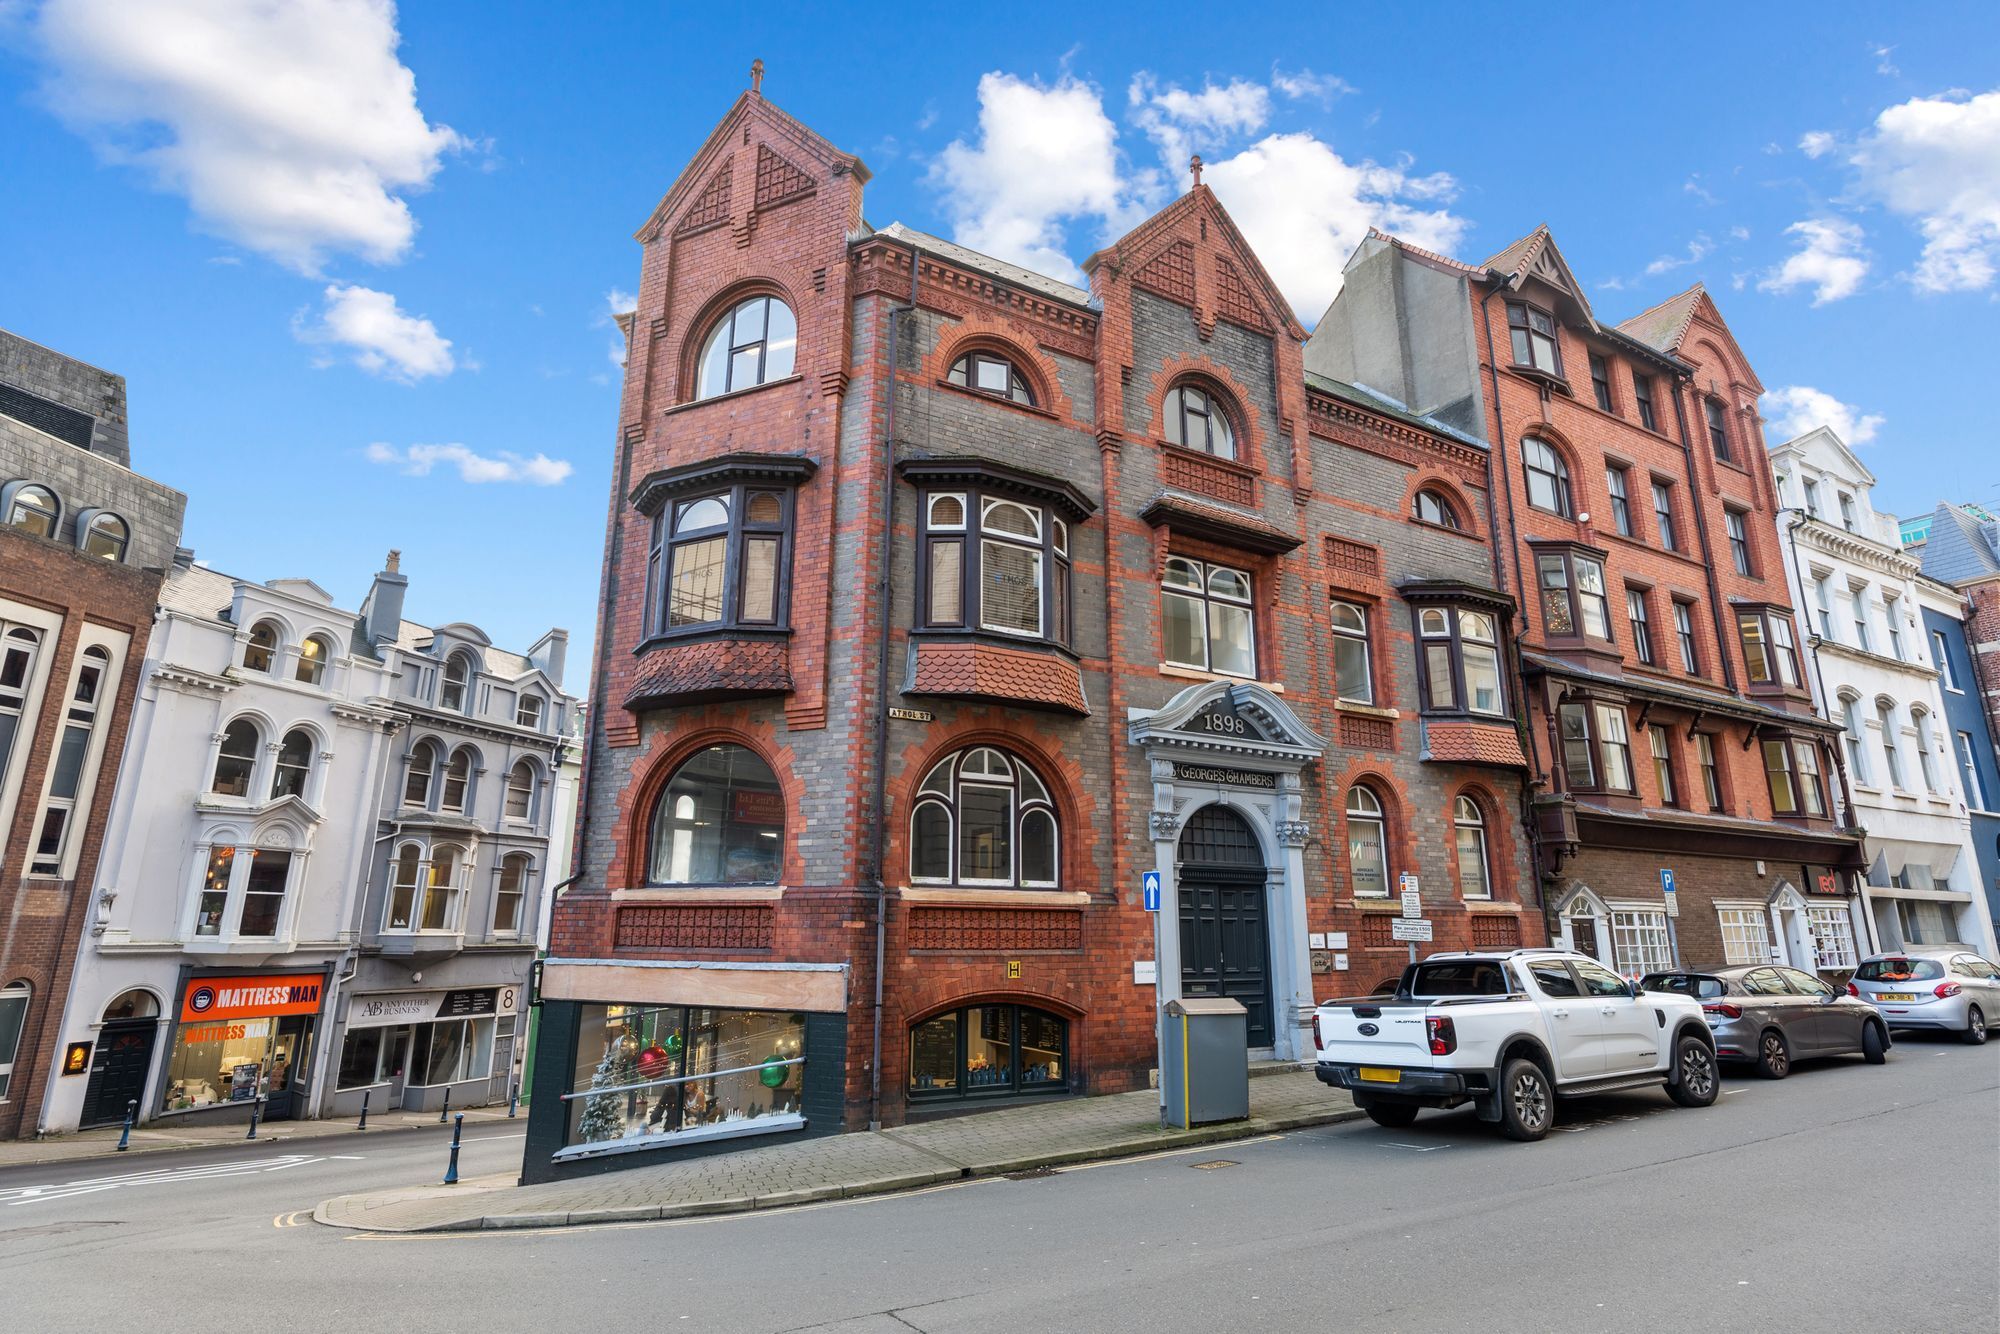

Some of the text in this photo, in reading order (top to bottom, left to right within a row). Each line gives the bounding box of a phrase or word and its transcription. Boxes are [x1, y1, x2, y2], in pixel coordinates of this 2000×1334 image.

[892, 710, 930, 720] ATHOL ST
[1204, 713, 1245, 734] 1898
[1664, 873, 1671, 889] P
[1817, 868, 1836, 893] red
[1009, 962, 1020, 977] H
[503, 989, 514, 1009] 8
[384, 1006, 421, 1016] BUSINESS
